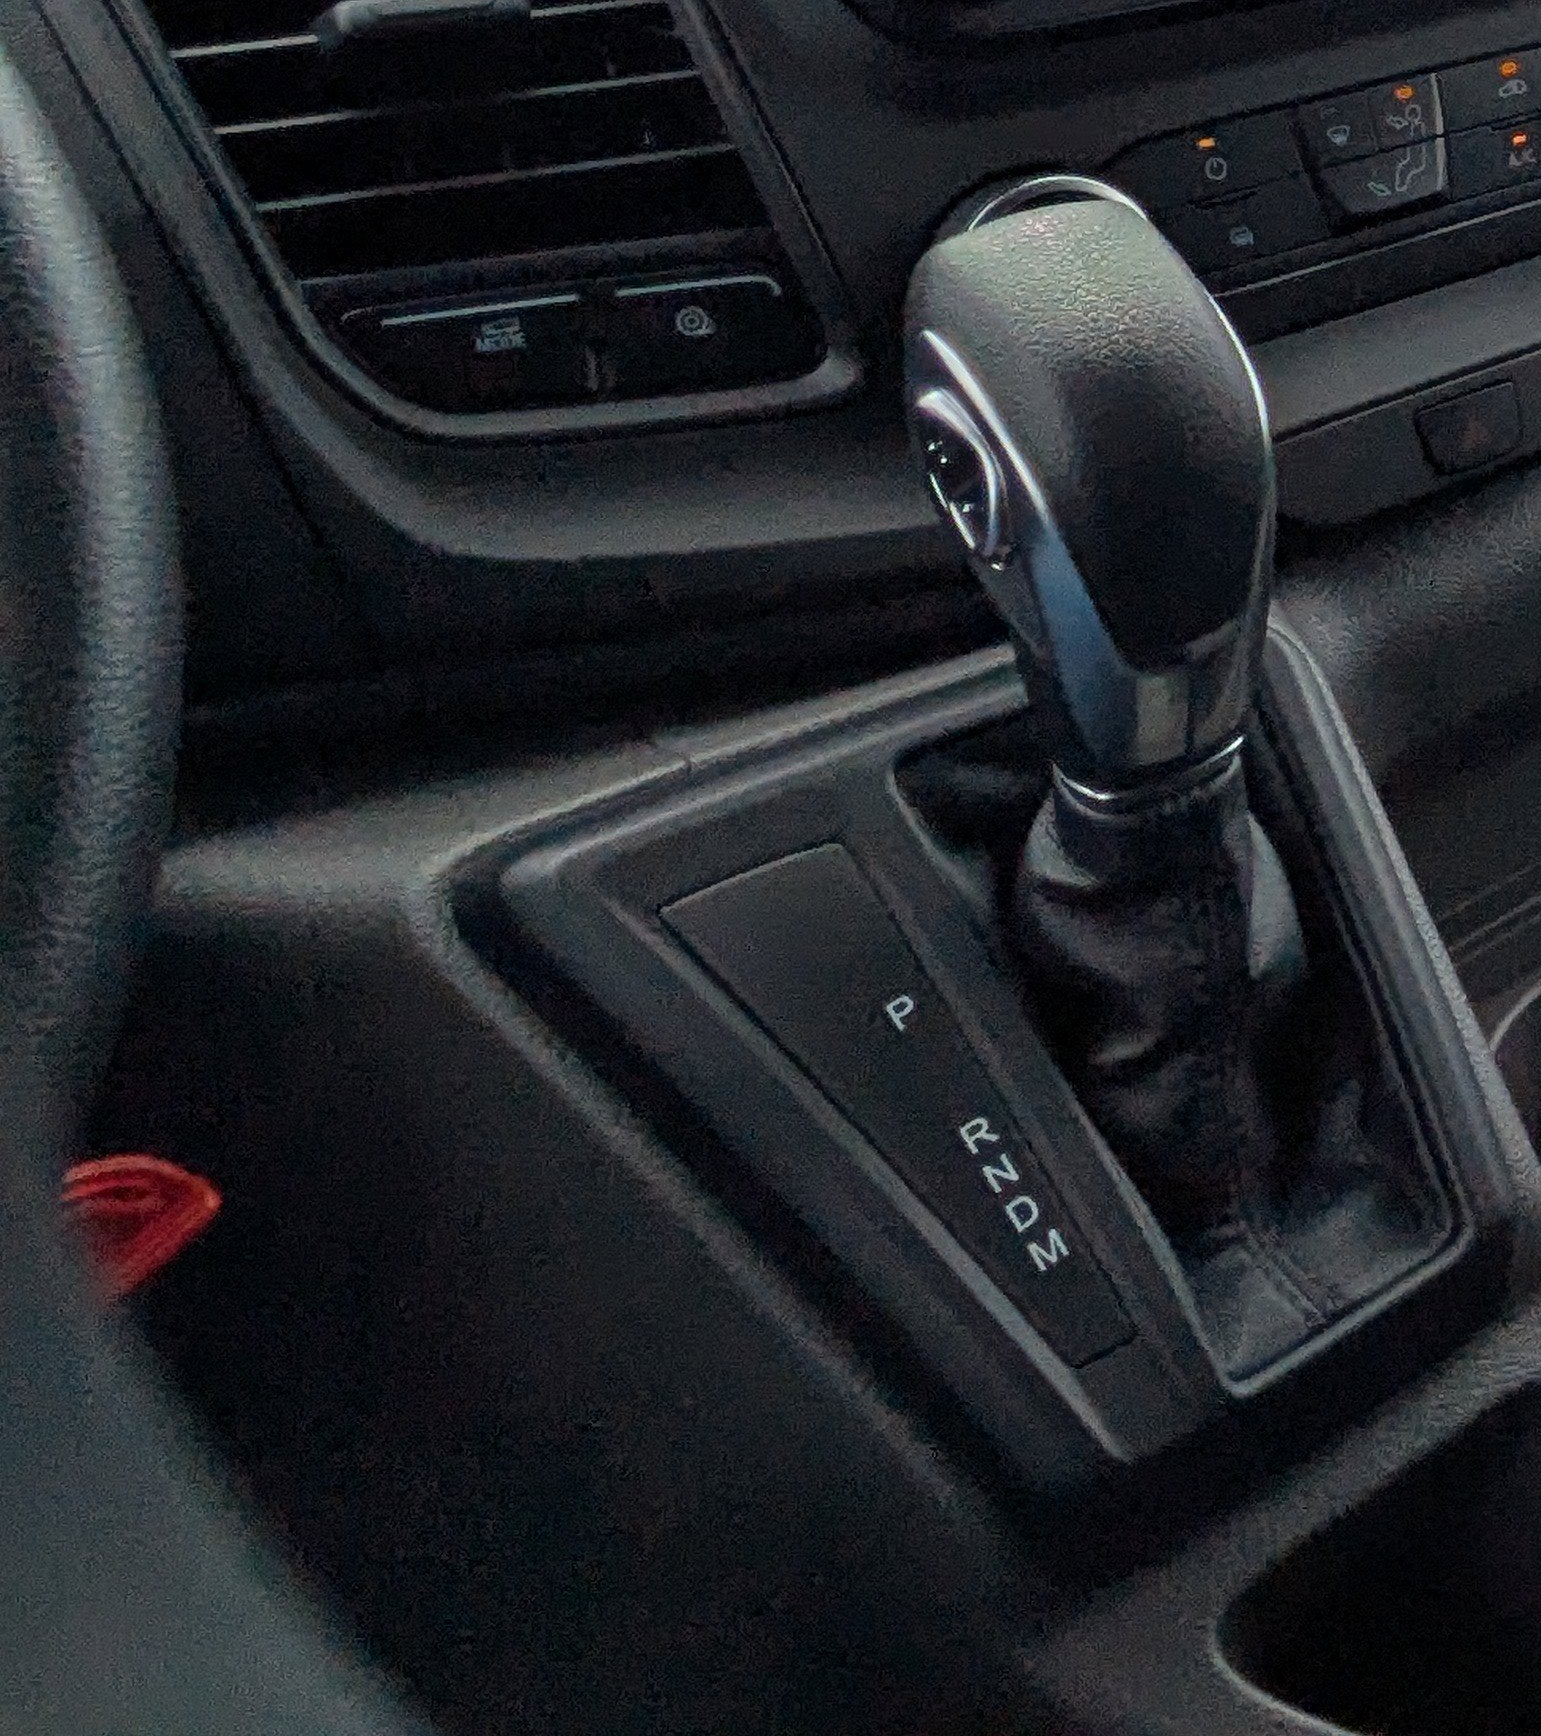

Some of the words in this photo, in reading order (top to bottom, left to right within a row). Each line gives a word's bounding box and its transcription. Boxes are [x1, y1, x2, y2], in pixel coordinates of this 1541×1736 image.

[886, 994, 915, 1032] P
[959, 1117, 1000, 1155] R
[982, 1153, 1019, 1194] N
[1005, 1196, 1039, 1233] D
[1027, 1228, 1070, 1271] M
